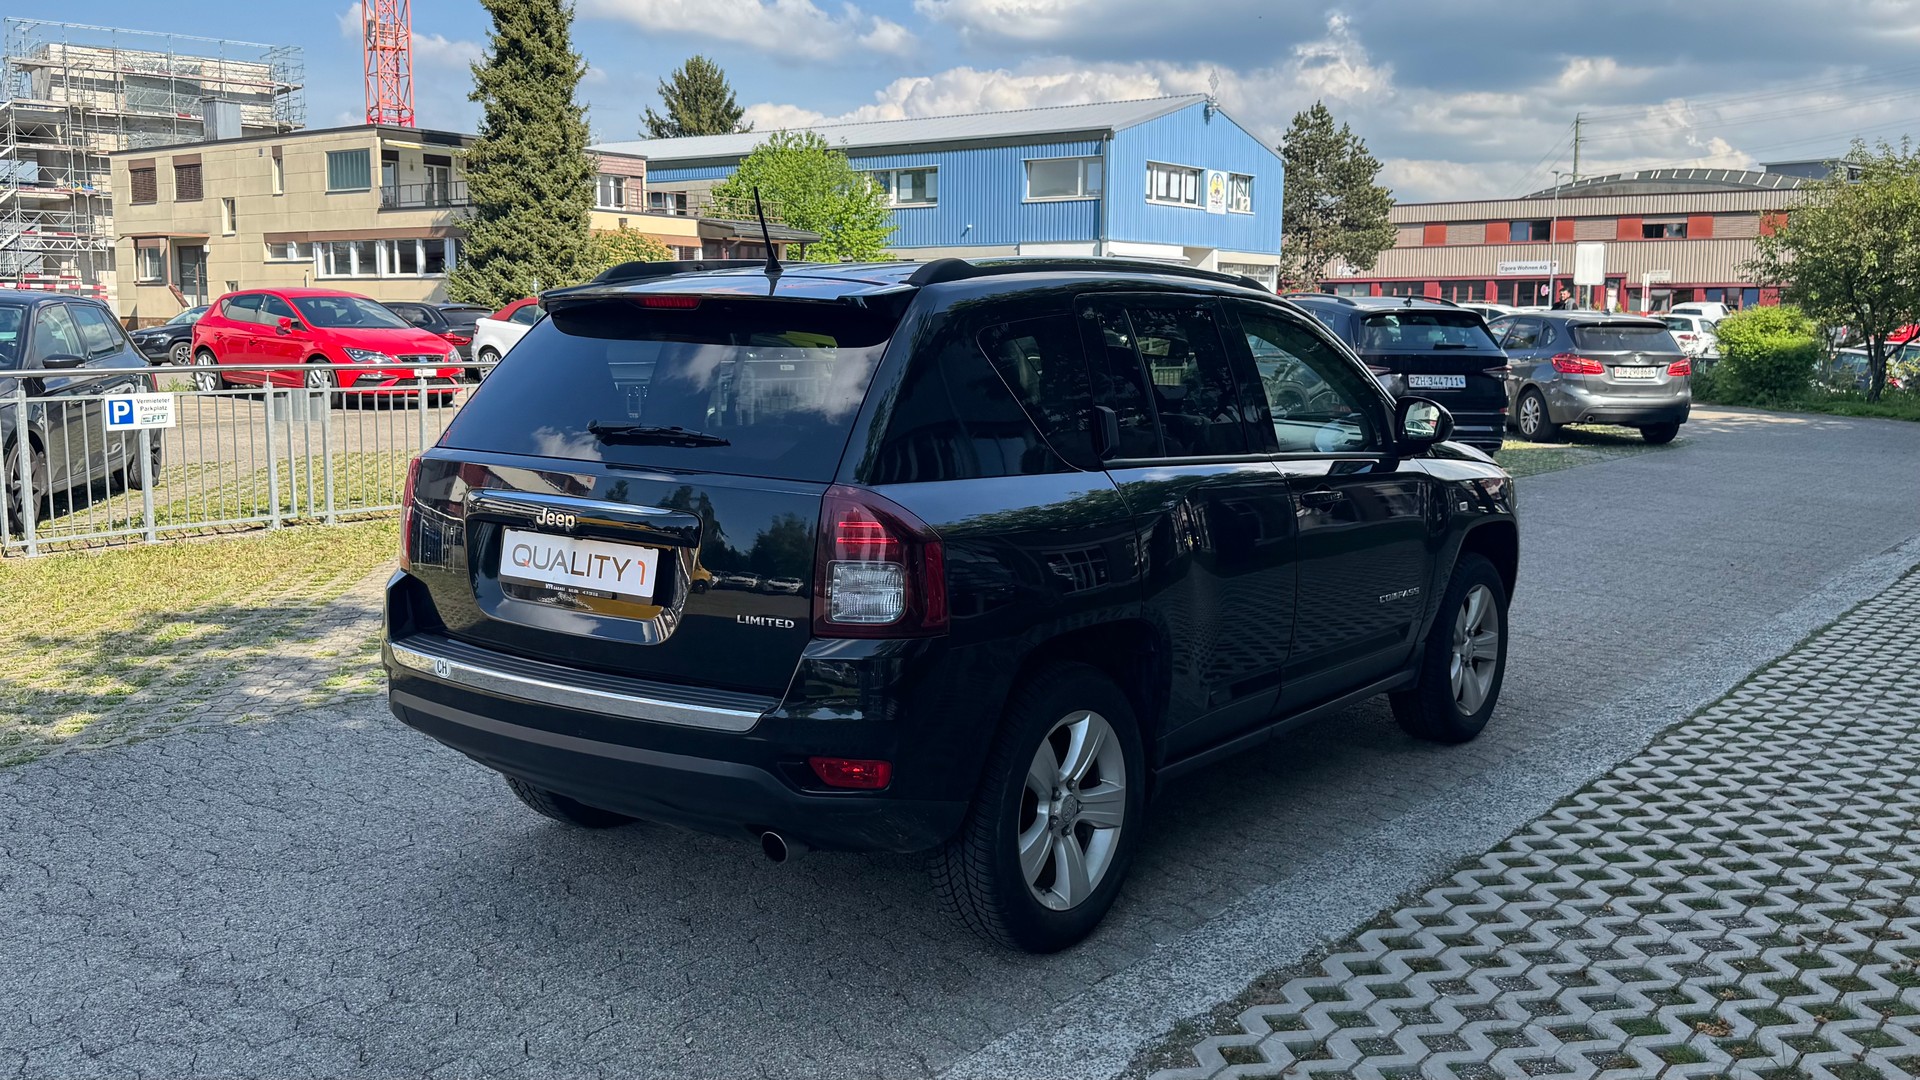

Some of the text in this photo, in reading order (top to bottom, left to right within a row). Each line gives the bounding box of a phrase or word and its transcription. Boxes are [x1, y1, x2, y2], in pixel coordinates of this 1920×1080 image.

[112, 401, 131, 424] P
[152, 414, 166, 422] FIT
[536, 507, 576, 533] Jeep
[512, 543, 646, 586] QUALITY 1
[1379, 586, 1420, 603] COMPASS
[736, 614, 795, 629] LIMITED
[436, 660, 448, 675] CH
